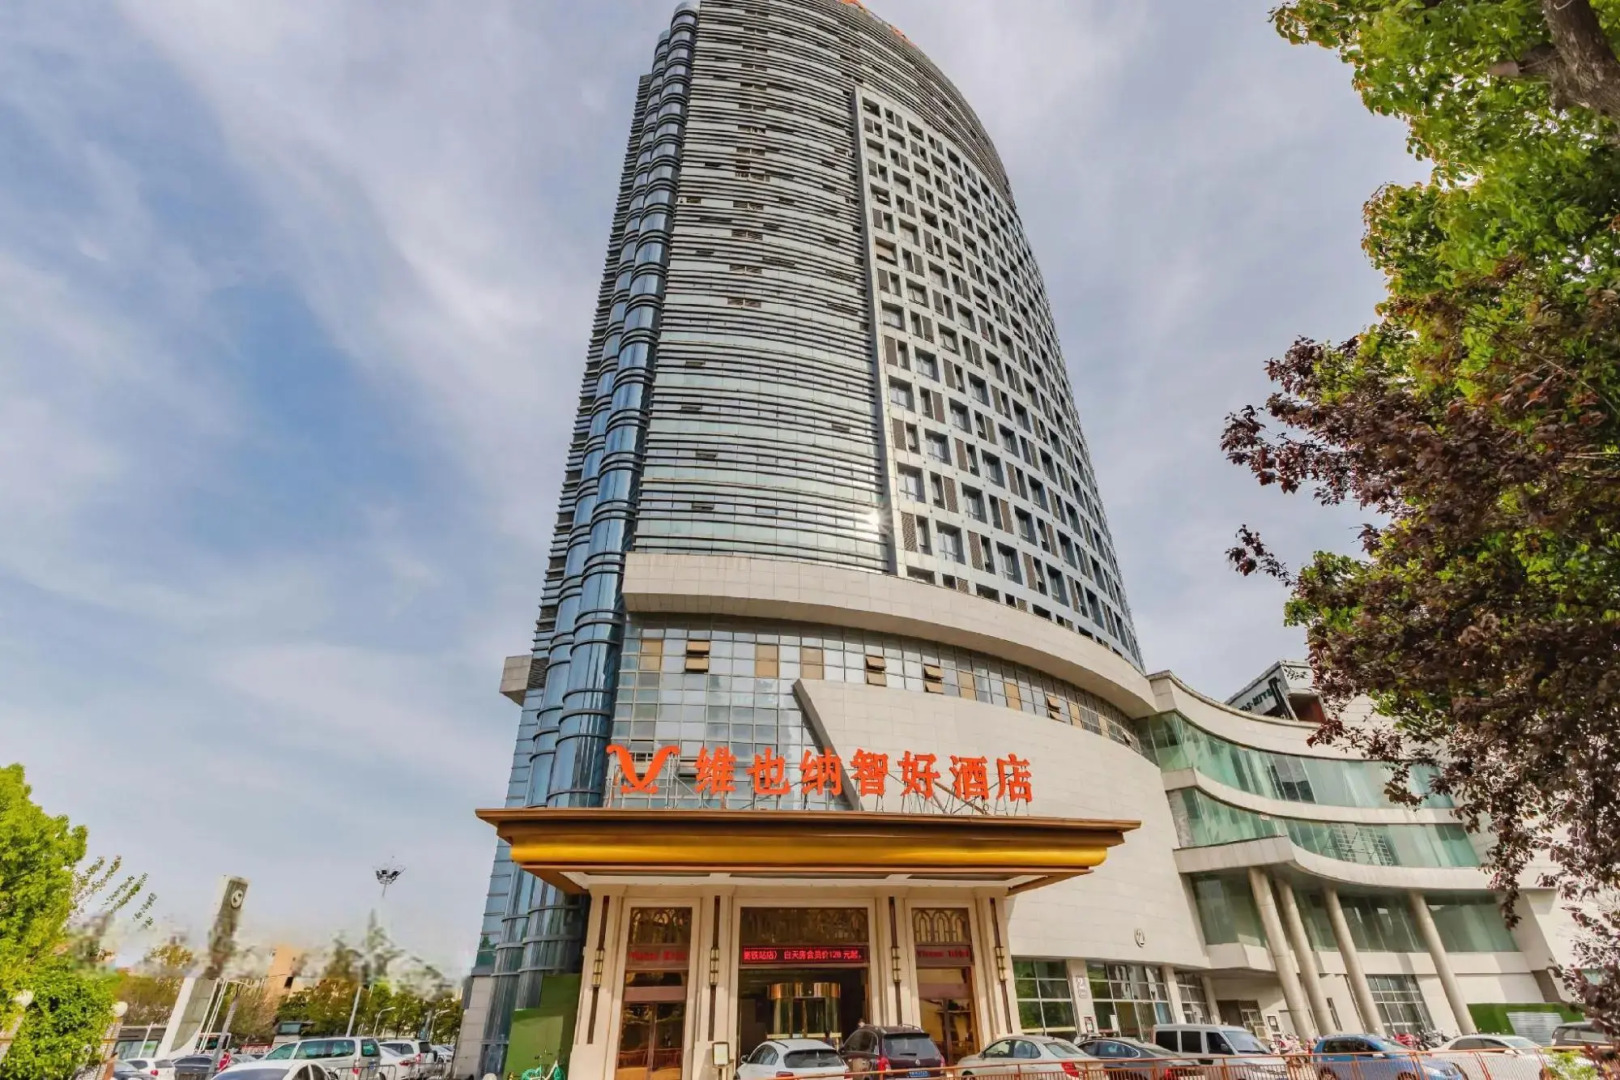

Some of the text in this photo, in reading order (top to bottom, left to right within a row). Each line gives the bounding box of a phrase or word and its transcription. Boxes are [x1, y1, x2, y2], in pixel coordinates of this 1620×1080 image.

[694, 746, 1033, 802] 维也纳智好酒店
